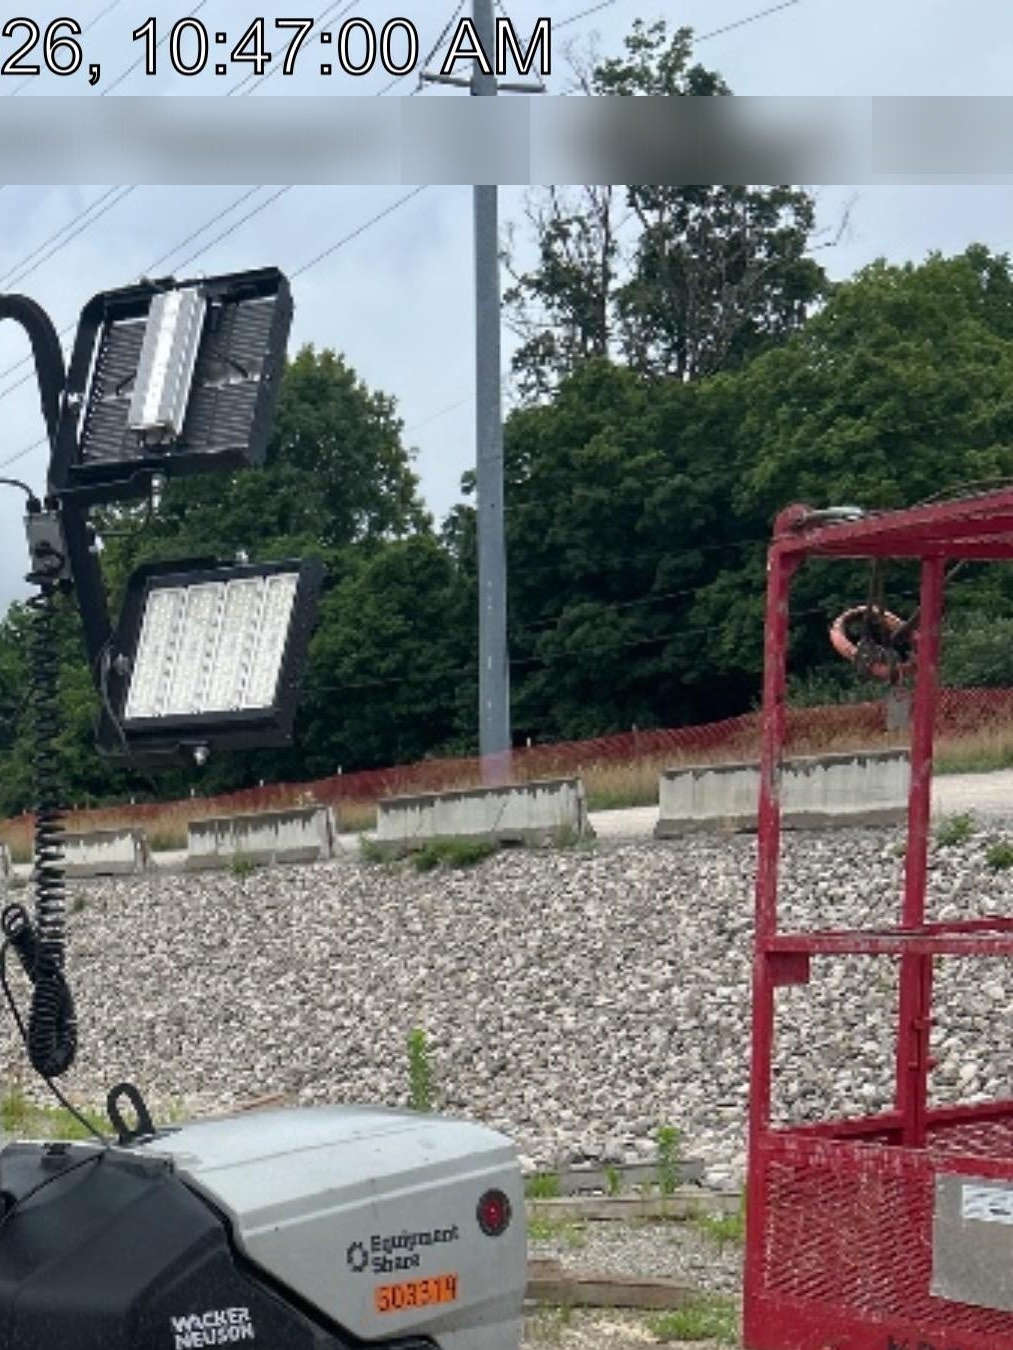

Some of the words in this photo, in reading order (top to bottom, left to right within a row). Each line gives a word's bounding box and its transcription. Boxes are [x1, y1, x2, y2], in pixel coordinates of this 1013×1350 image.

[371, 1224, 459, 1254] Equipment
[372, 1254, 419, 1273] Share
[170, 1307, 251, 1333] WACKER
[175, 1322, 255, 1350] NEUSON
